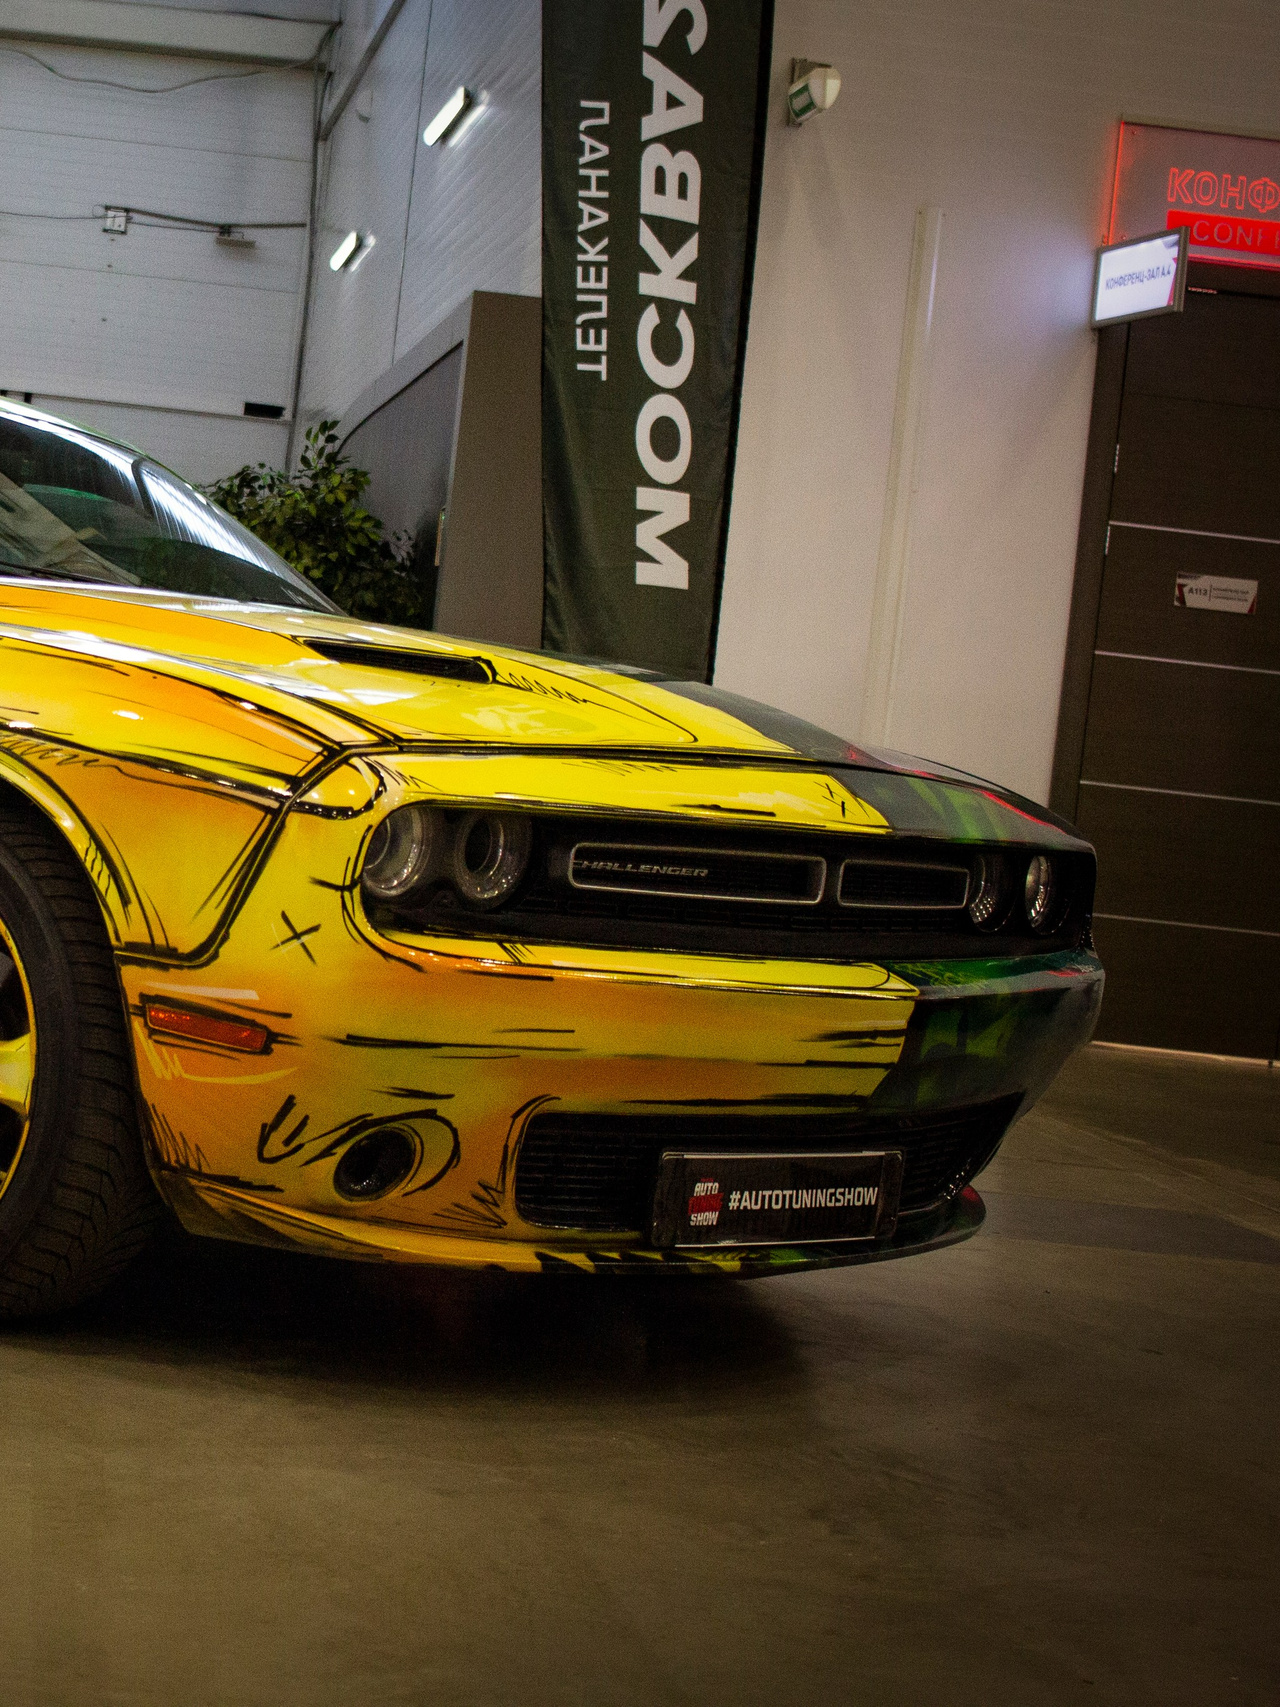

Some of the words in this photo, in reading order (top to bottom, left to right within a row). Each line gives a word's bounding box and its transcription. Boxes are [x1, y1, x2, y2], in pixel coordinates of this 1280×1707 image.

[1105, 267, 1160, 291] КОНФЕРЕНЦ-ЗАЛ
[693, 1182, 719, 1196] AUTO
[728, 1187, 879, 1210] #AUTOTUNINGSHOW
[689, 1211, 719, 1226] SHOW
